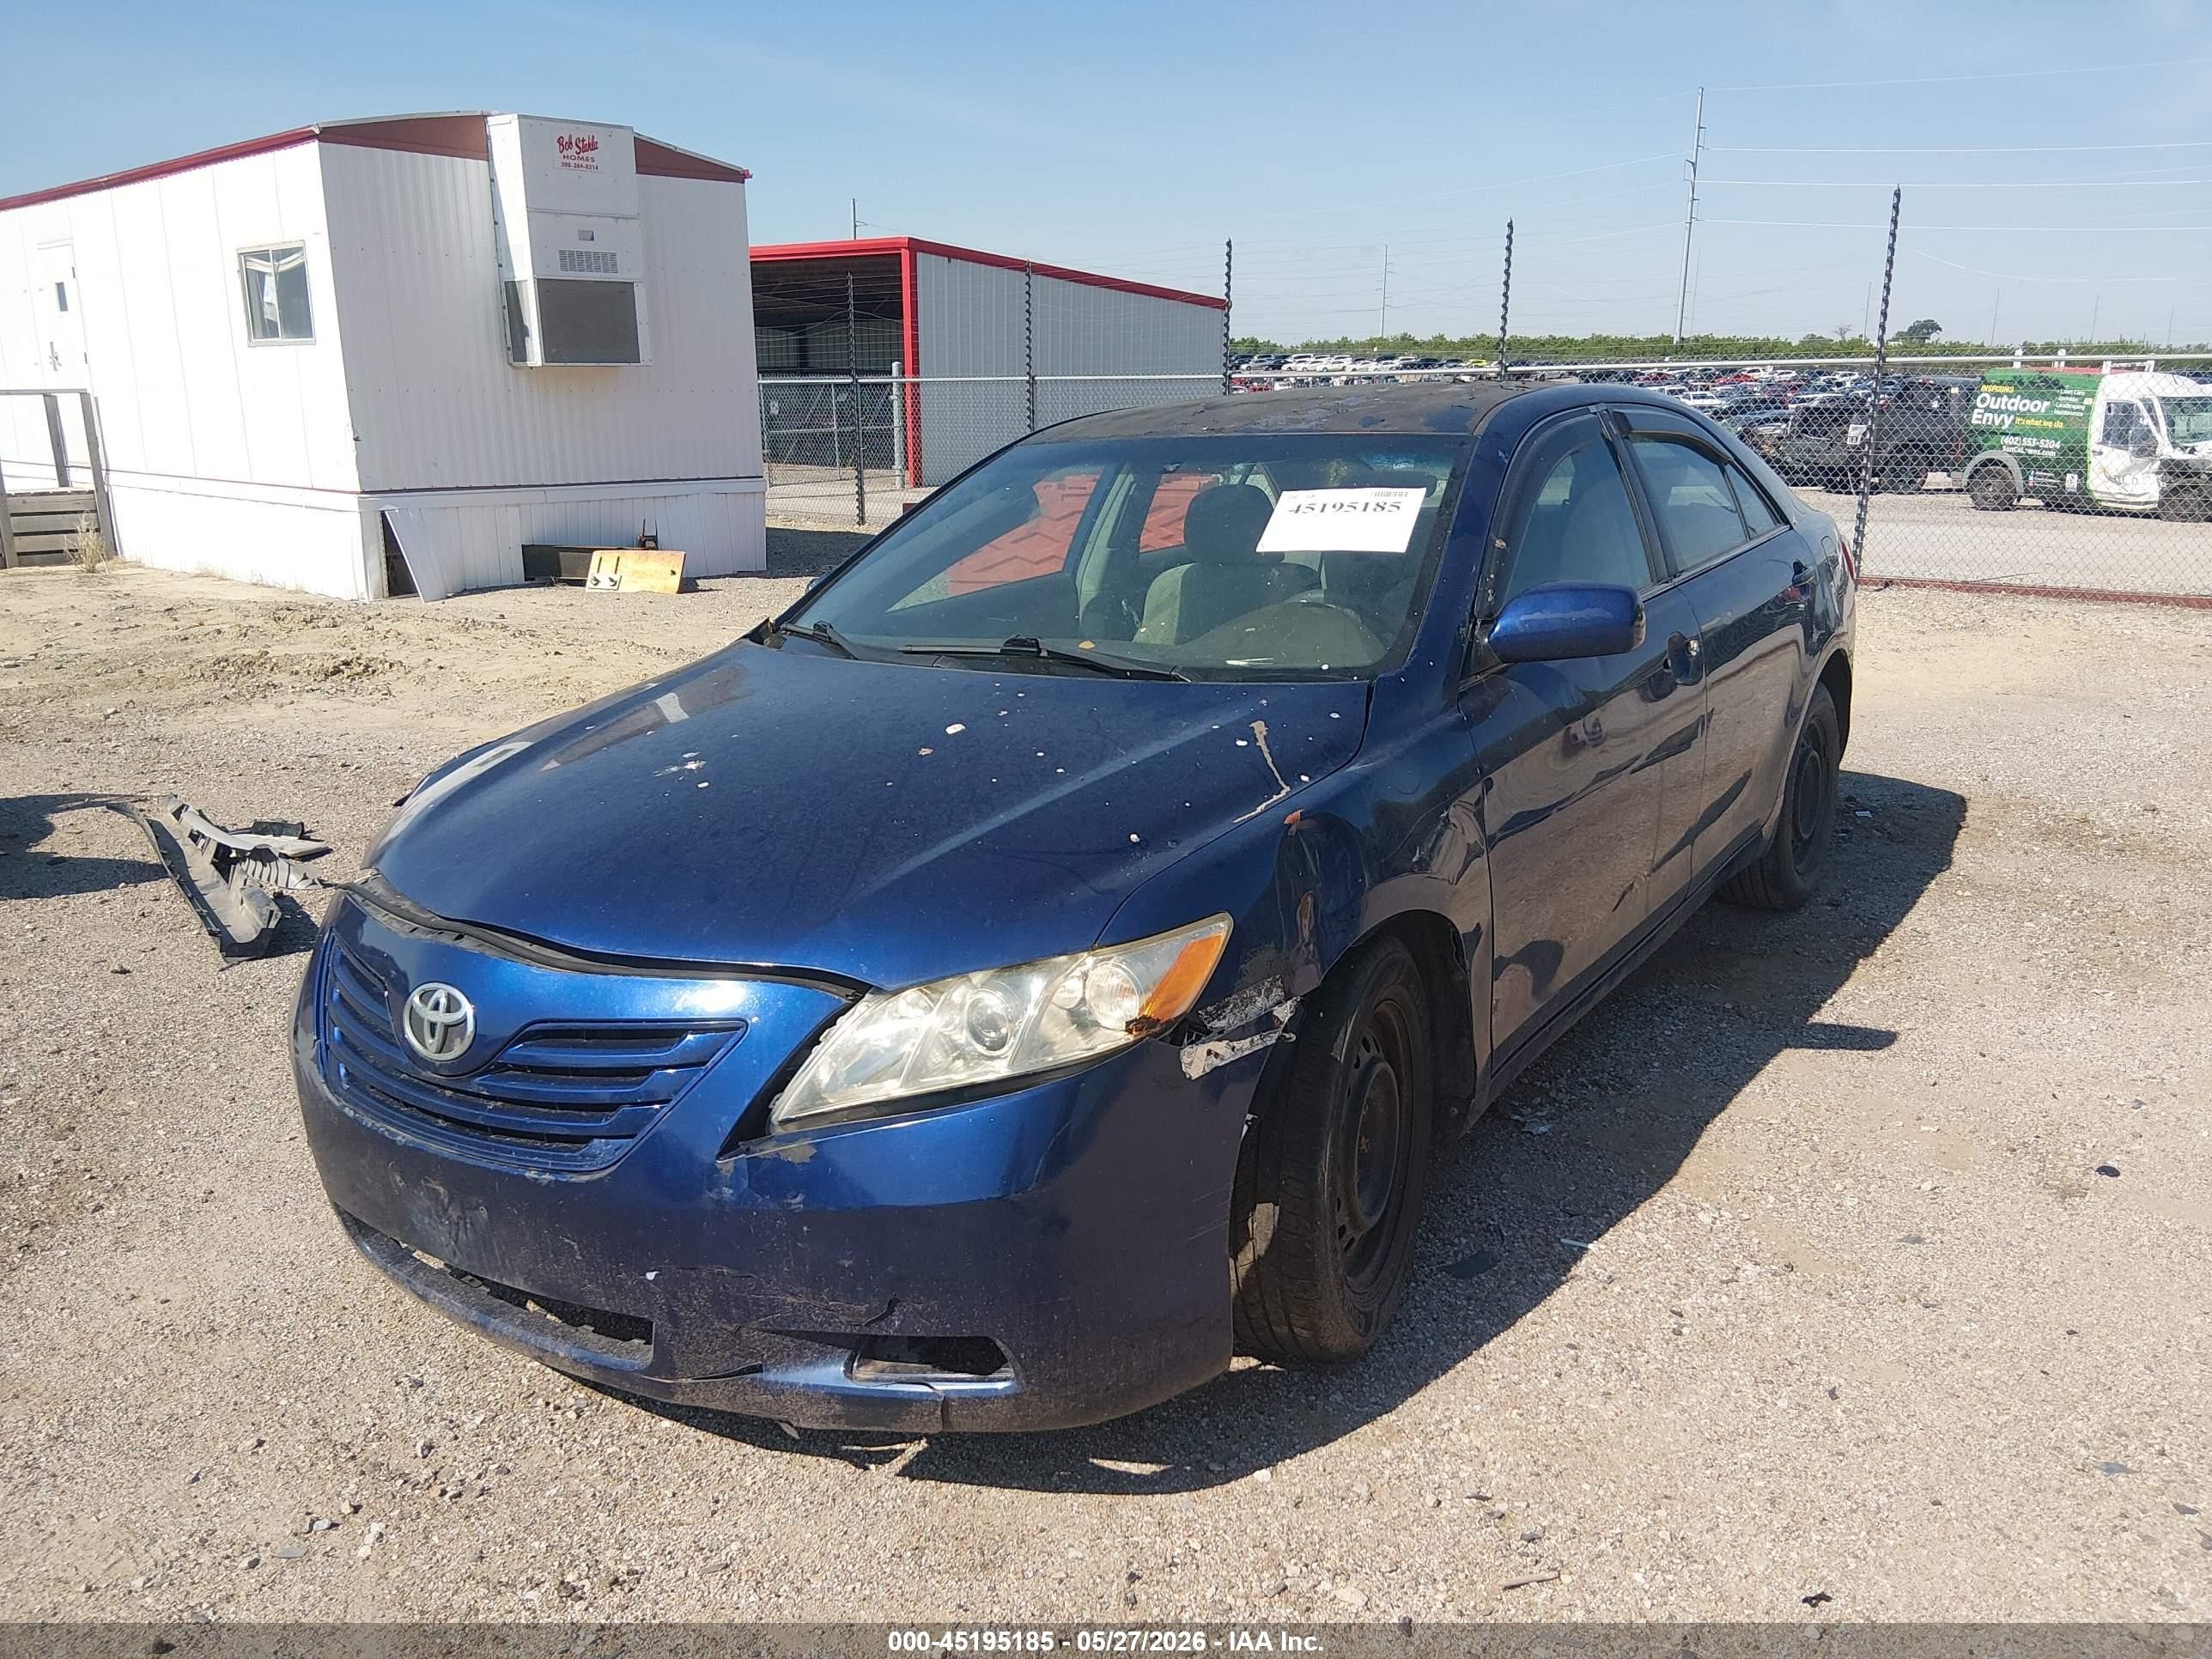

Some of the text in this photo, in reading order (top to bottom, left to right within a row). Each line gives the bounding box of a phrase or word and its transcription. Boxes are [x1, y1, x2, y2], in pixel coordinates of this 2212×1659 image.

[556, 134, 574, 154] Bob
[1976, 392, 2051, 412] Outdoor
[1971, 408, 2014, 429] Envy
[1288, 501, 1402, 514] 45195185
